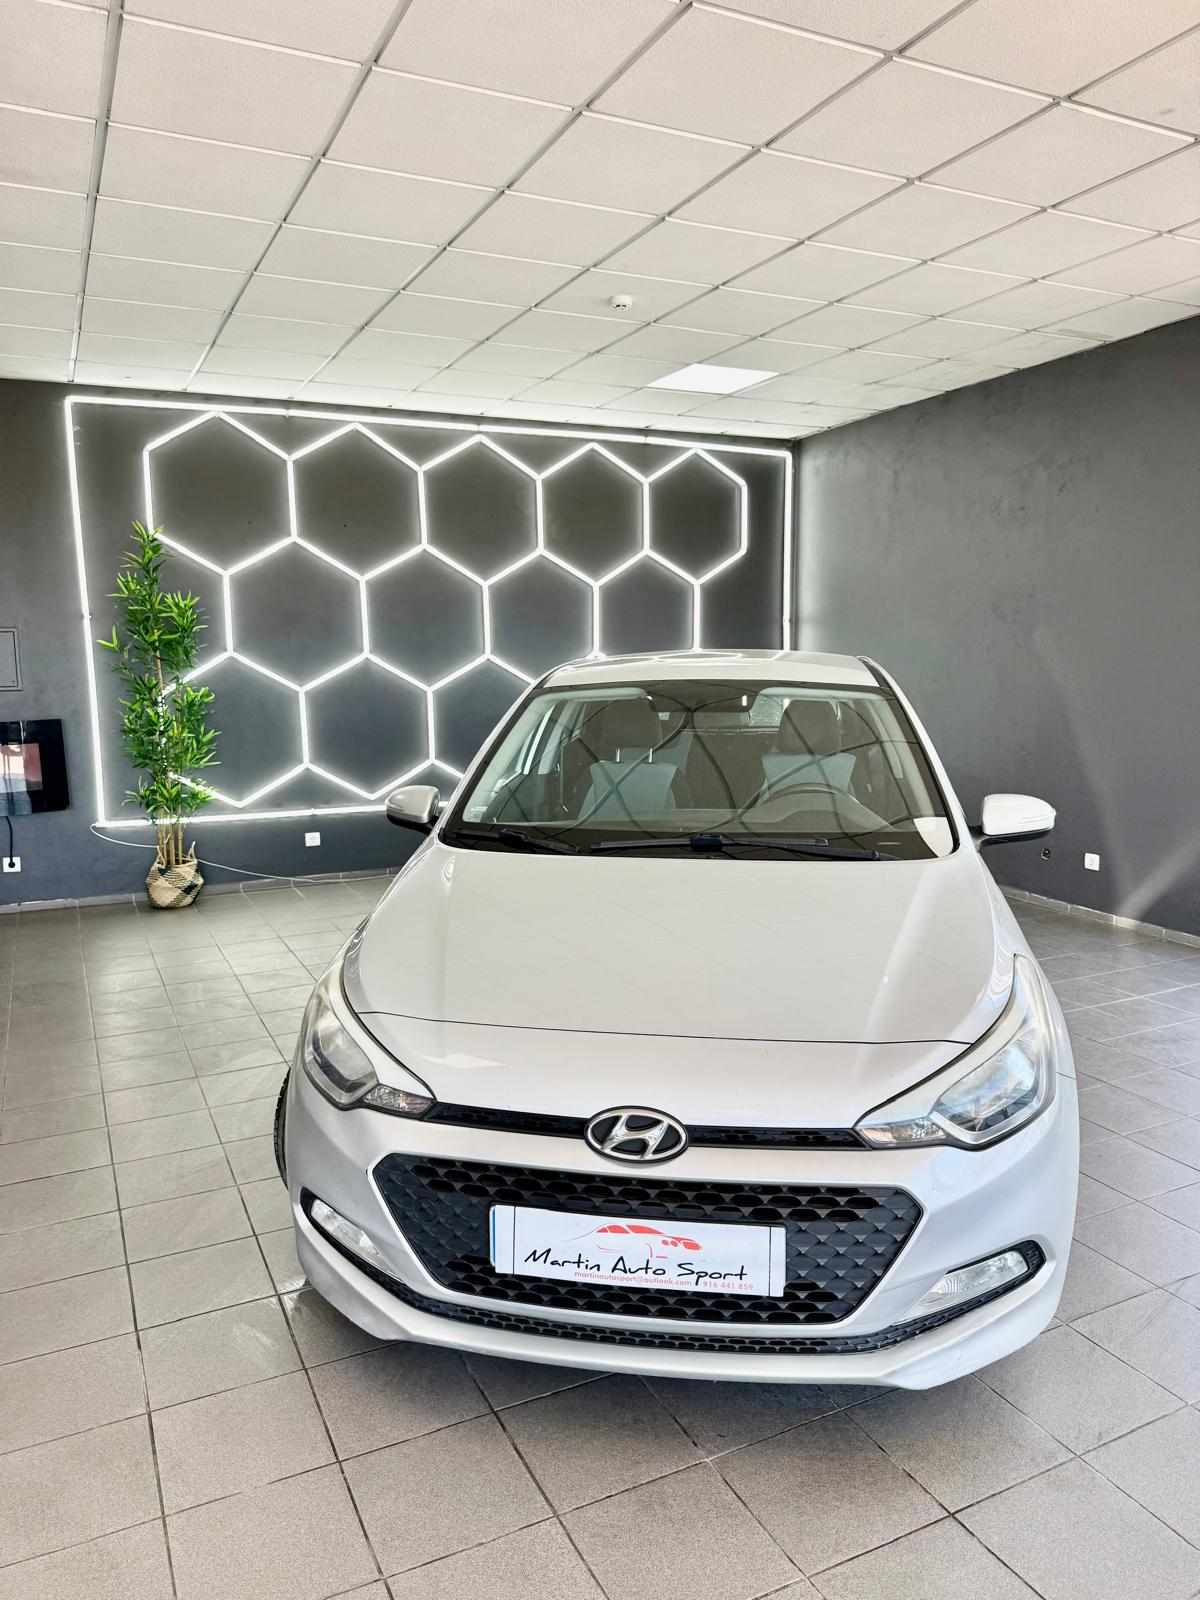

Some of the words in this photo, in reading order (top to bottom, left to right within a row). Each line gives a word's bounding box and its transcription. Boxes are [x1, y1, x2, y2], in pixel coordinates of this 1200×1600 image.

[524, 1247, 601, 1272] Martin
[611, 1255, 666, 1275] Auto
[676, 1262, 748, 1286] Sport
